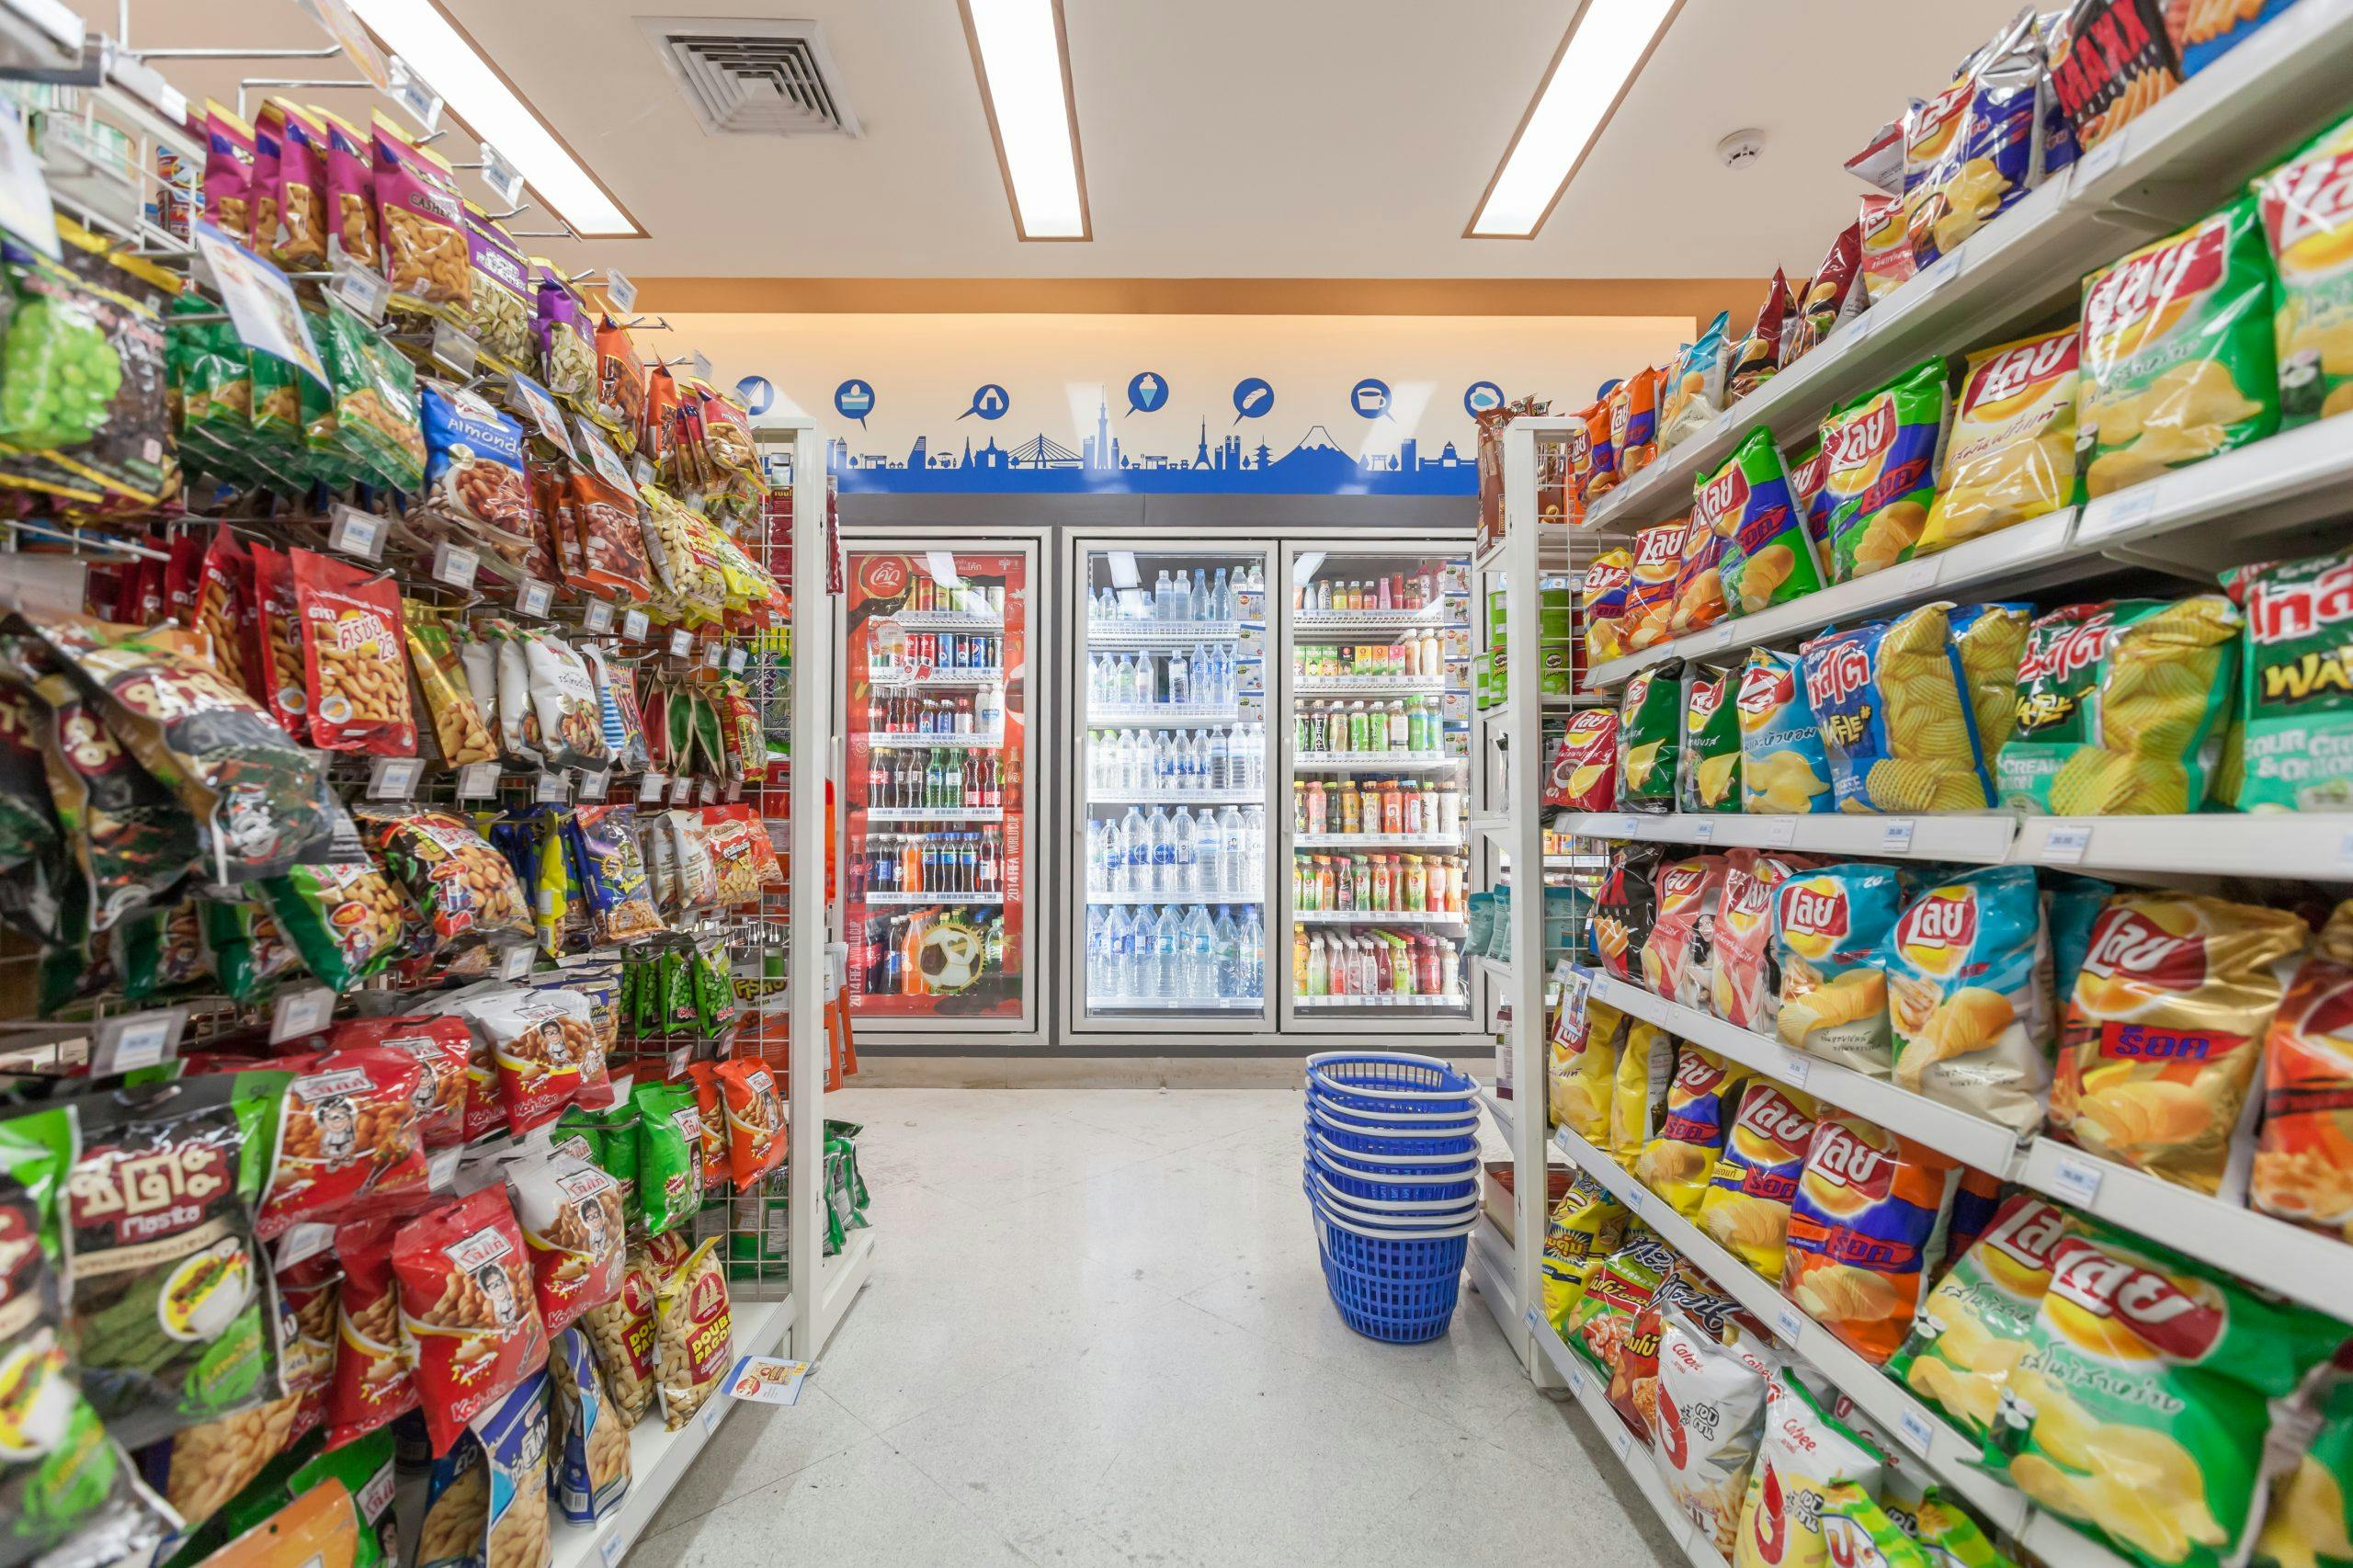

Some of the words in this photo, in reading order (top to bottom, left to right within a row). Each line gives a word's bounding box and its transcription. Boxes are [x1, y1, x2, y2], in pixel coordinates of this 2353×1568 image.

[409, 192, 461, 222] CASHE
[1006, 814, 1019, 829] CUP
[1006, 830, 1019, 854] WORLD
[1006, 858, 1019, 875] FIFA
[1006, 876, 1019, 901] 2014
[849, 963, 861, 982] FIFA
